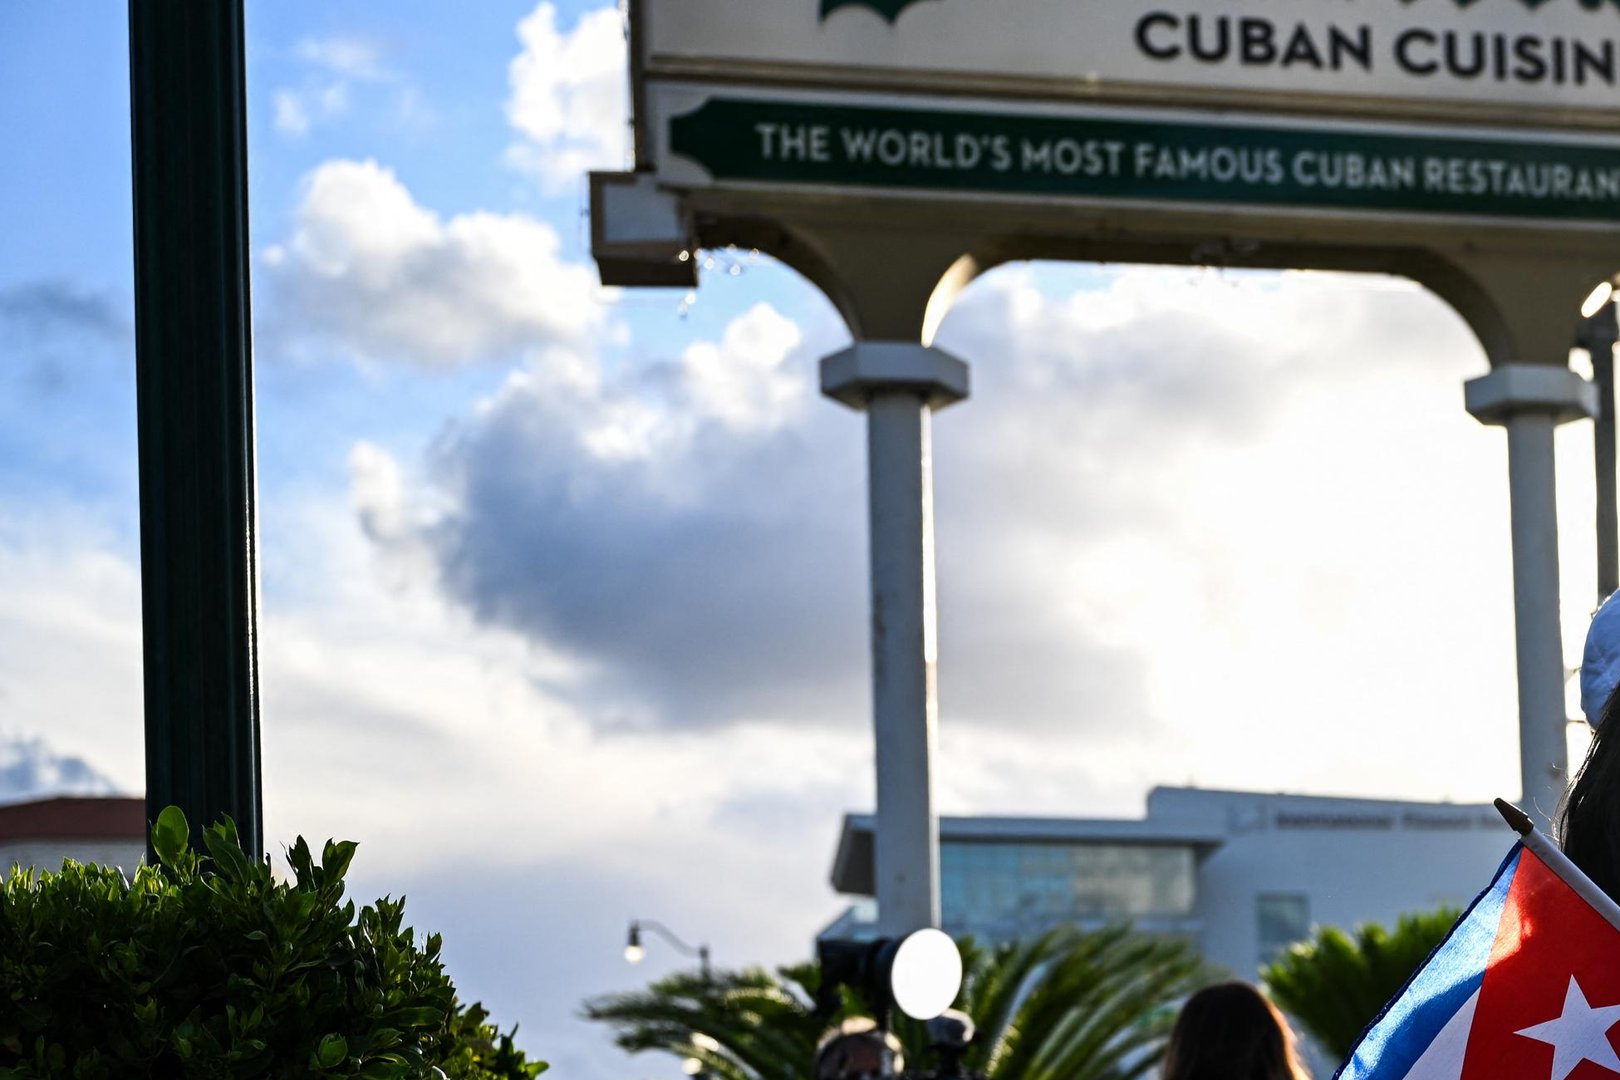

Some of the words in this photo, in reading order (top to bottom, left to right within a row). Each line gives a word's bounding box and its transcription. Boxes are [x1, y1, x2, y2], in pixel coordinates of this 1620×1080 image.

[1134, 12, 1371, 70] CUBAN
[756, 123, 829, 161] THE
[842, 131, 1011, 170] WORLD'S
[1022, 139, 1123, 175] MOST
[1134, 143, 1284, 185] FAMOUS
[1293, 150, 1415, 188] CUBAN
